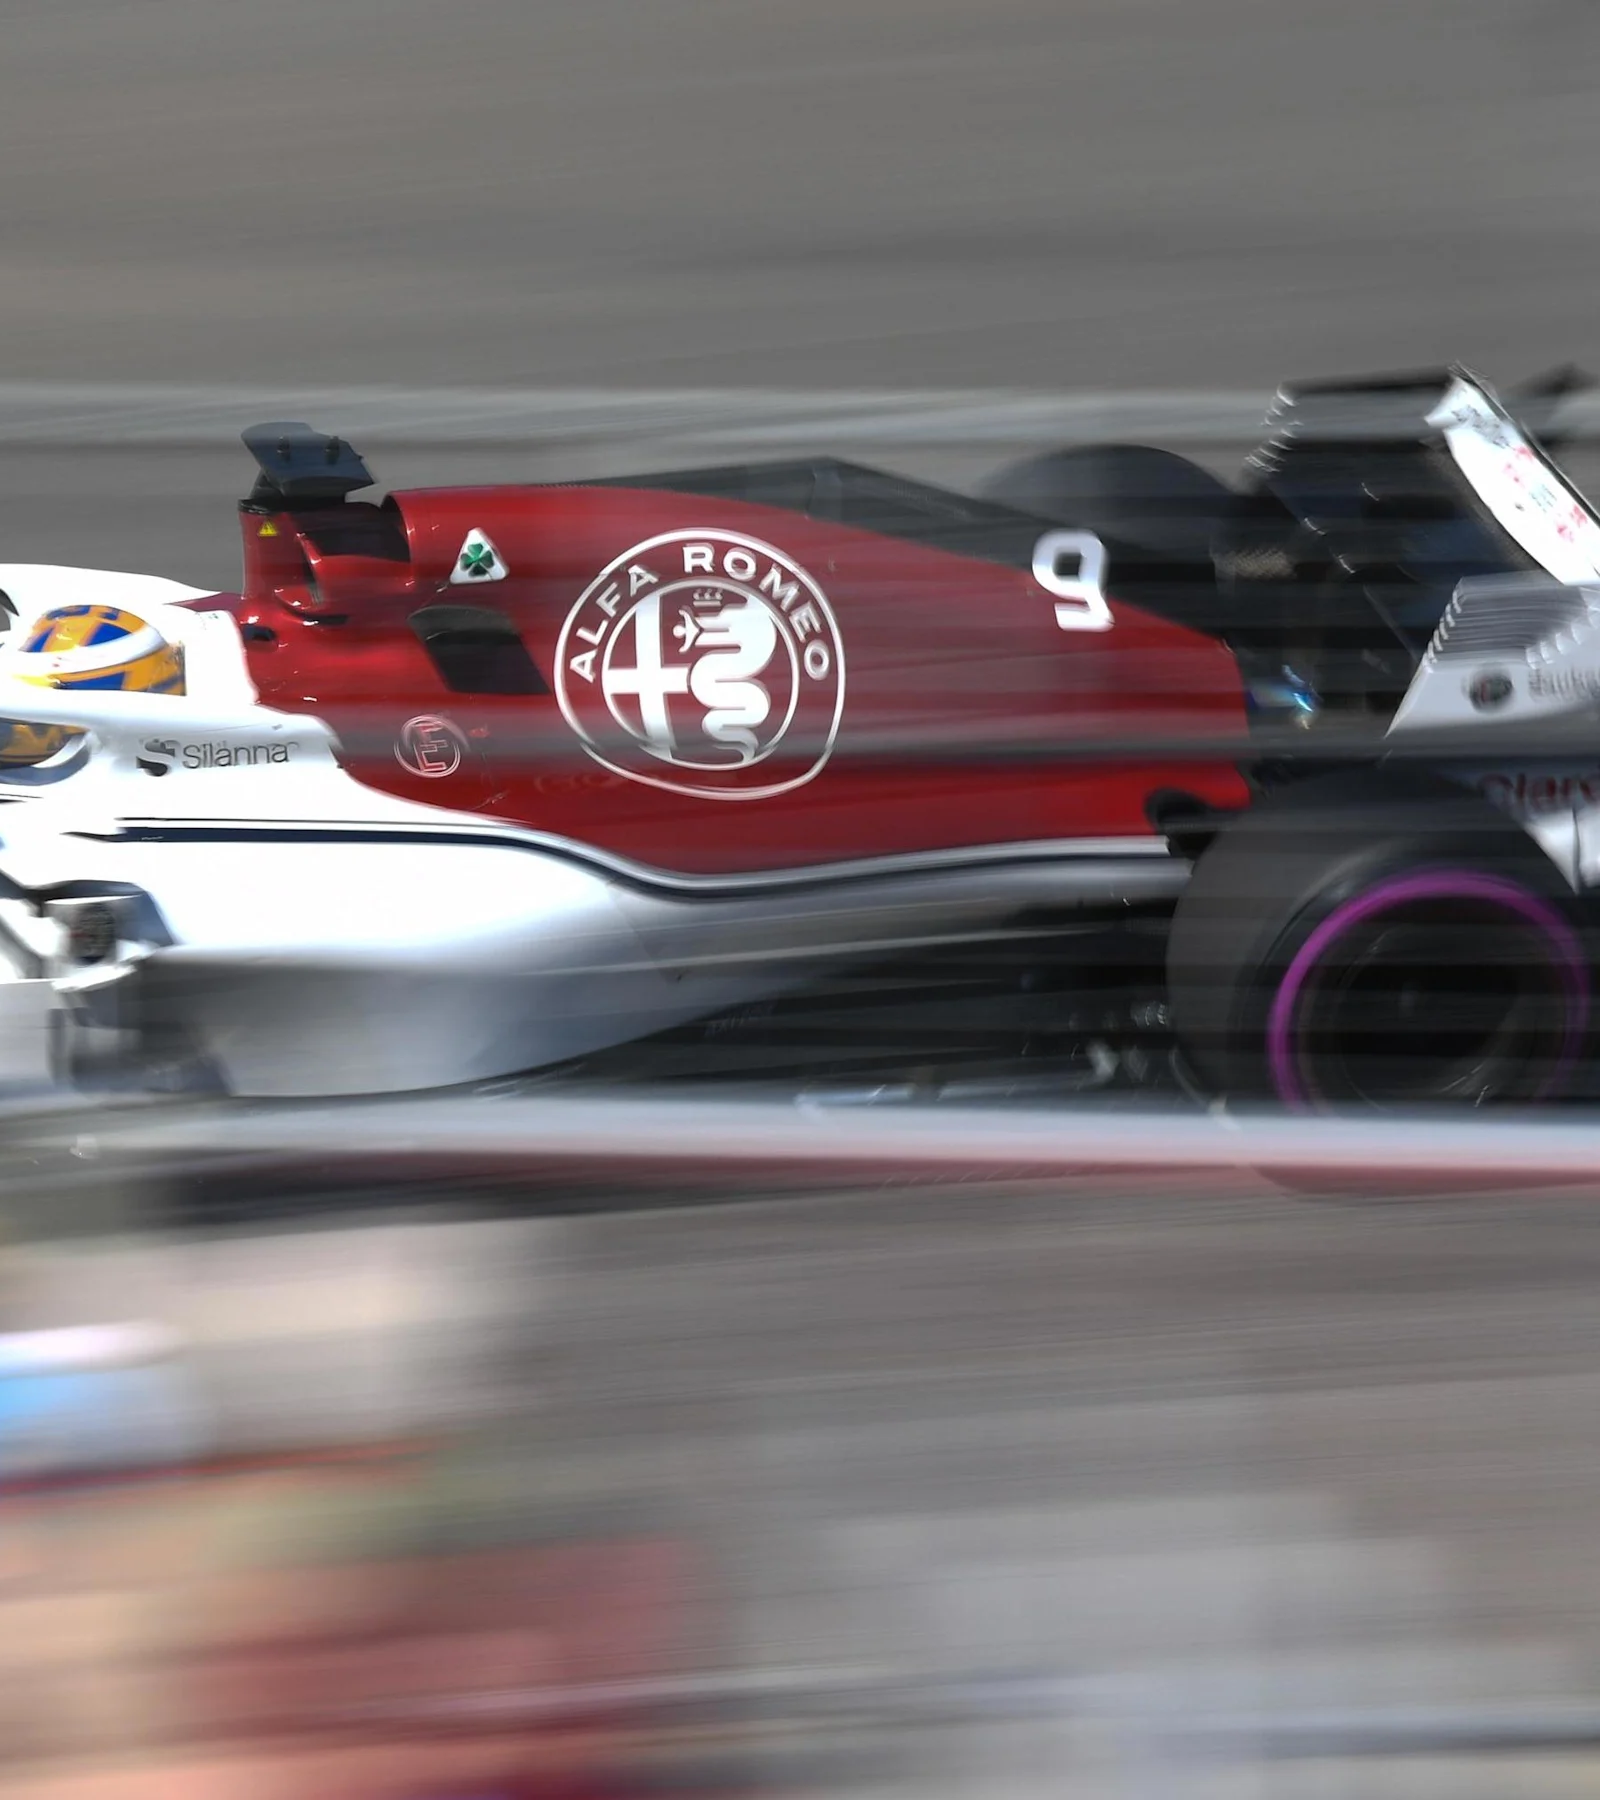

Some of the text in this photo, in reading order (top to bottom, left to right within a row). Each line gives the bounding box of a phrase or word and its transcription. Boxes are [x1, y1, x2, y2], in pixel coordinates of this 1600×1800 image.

[569, 543, 830, 683] ALFA ROMEO
[1032, 528, 1115, 632] 9
